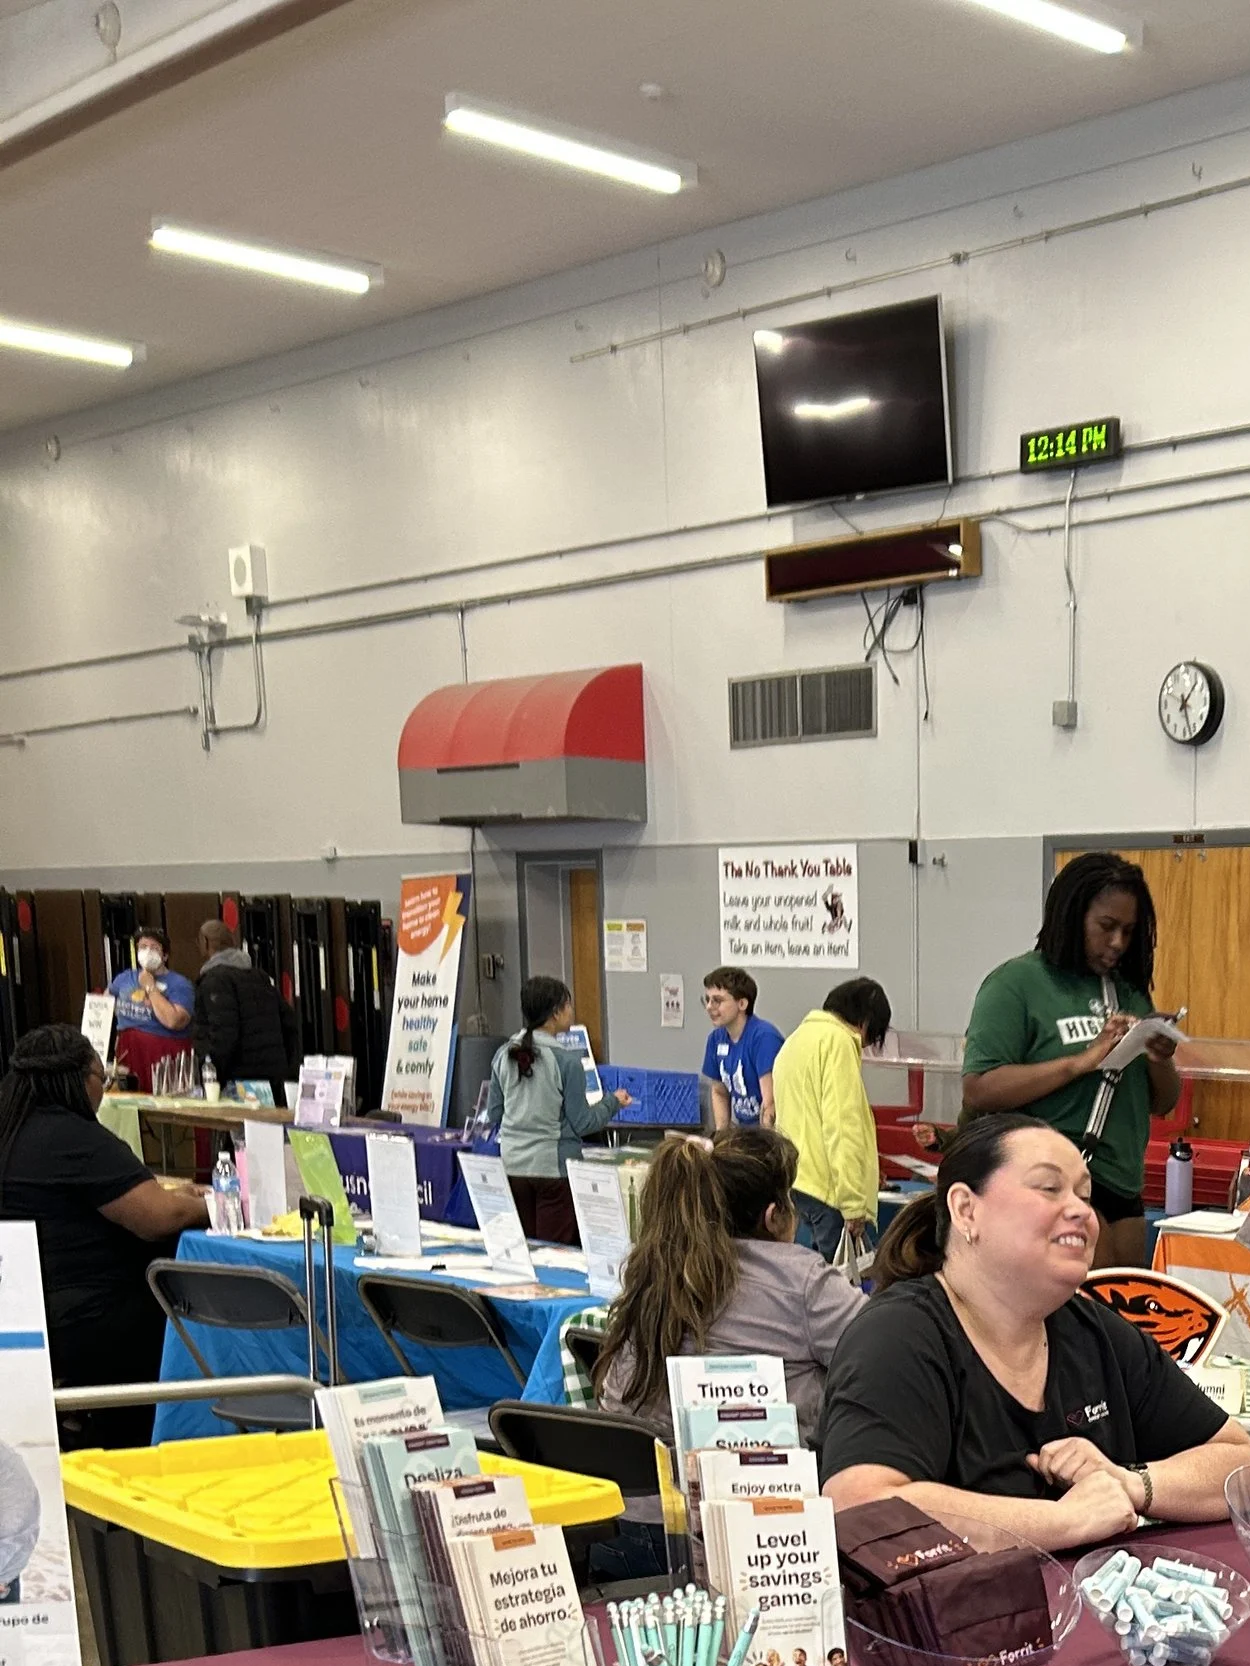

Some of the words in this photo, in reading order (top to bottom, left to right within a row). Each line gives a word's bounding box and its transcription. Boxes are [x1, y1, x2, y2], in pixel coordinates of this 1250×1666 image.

[1027, 430, 1077, 462] 12:14
[1082, 424, 1106, 454] PM
[723, 860, 743, 878] The
[745, 860, 760, 878] No
[763, 859, 798, 878] Thank
[800, 859, 821, 878] You
[823, 857, 852, 877] Table
[723, 890, 749, 908] Leave
[752, 895, 772, 912] your
[774, 890, 817, 912] unopened
[744, 914, 760, 931] and
[763, 914, 788, 932] whole
[729, 938, 748, 955] Take
[751, 944, 762, 955] an
[788, 938, 810, 956] leave
[813, 944, 825, 956] an
[412, 970, 437, 987] Make
[398, 996, 419, 1013] your
[421, 993, 449, 1008] home
[402, 1015, 438, 1034] healthy
[408, 1037, 428, 1053] safe
[396, 1060, 404, 1075] &
[405, 1057, 434, 1079] comfy
[698, 1383, 744, 1398] Time
[749, 1383, 769, 1398] to
[366, 1408, 412, 1425] momento
[413, 1404, 427, 1417] de
[732, 1482, 766, 1497] Enjoy
[768, 1481, 801, 1493] extra
[494, 1507, 507, 1519] de
[757, 1530, 807, 1549] Level
[747, 1553, 771, 1570] up
[776, 1550, 820, 1569] your
[489, 1567, 539, 1589] Mejora
[540, 1562, 558, 1577] tu
[749, 1569, 822, 1589] savings
[758, 1591, 818, 1612] game.
[32, 1614, 49, 1624] de
[500, 1617, 517, 1634] de
[519, 1607, 572, 1631] ahorro.
[1000, 1641, 1034, 1666] Forrit
